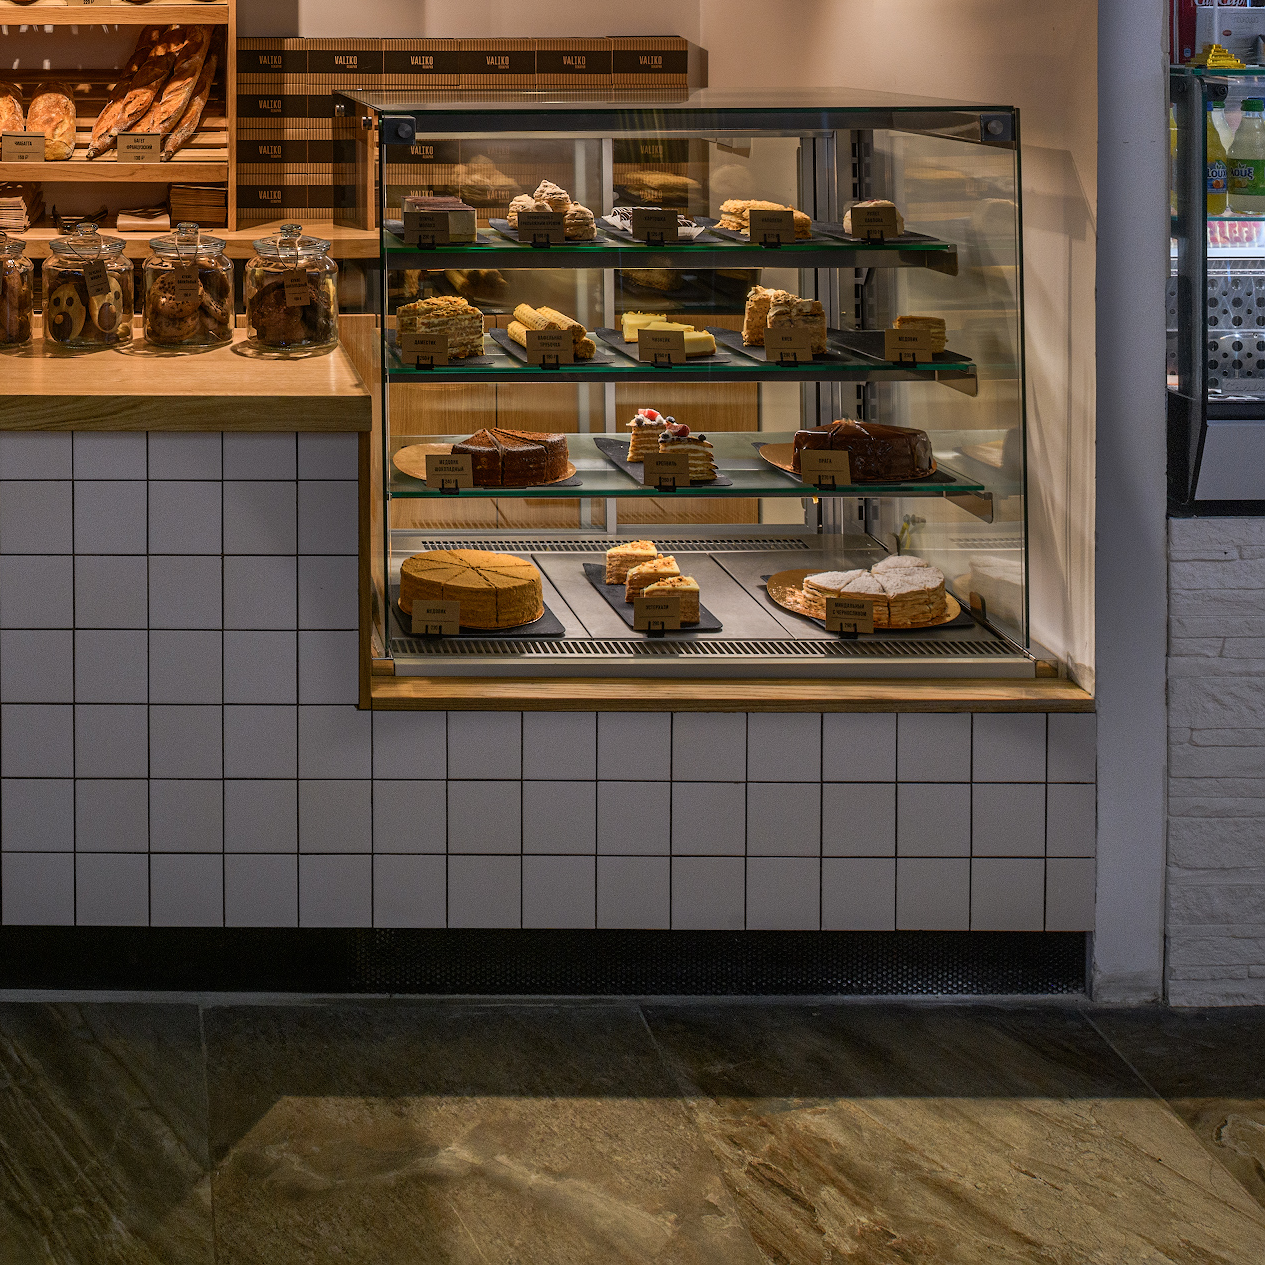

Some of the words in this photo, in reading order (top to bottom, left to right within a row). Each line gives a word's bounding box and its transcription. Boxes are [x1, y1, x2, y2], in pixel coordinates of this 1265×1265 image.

[258, 55, 282, 65] VALIKO
[334, 55, 358, 65] VALIKO
[410, 55, 434, 66] VALIKO
[486, 55, 510, 66] VALIKO
[563, 55, 587, 65] VALIKO
[639, 55, 663, 65] VALIKO
[258, 99, 282, 109] VALIKO
[258, 145, 282, 155] VALIKO
[410, 145, 434, 155] VALIKO
[258, 190, 282, 200] VALIKO
